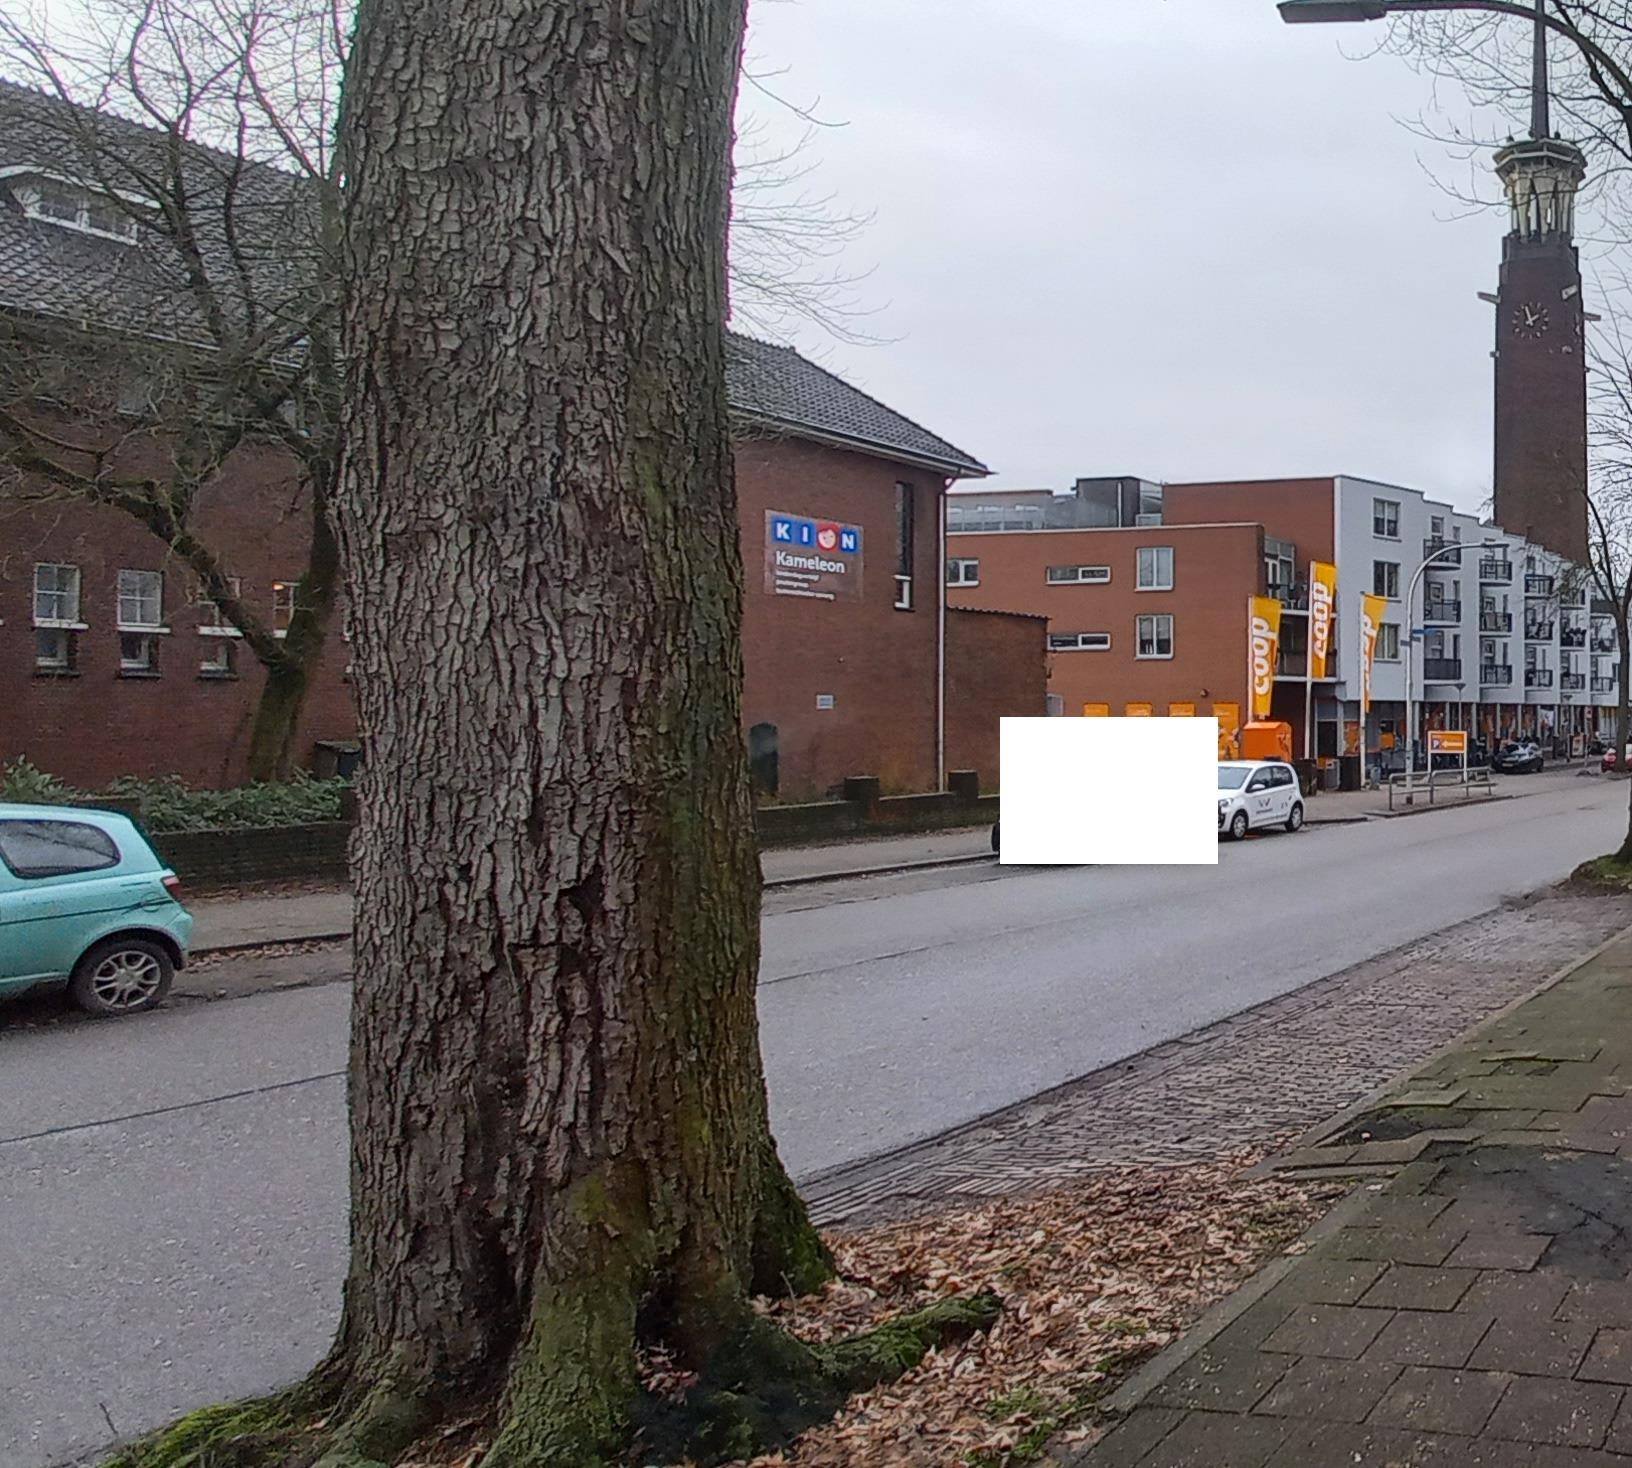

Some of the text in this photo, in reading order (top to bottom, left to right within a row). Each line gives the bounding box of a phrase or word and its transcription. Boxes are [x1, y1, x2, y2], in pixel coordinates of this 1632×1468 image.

[776, 550, 845, 573] Kameleon
[1252, 616, 1278, 695] coop
[1314, 582, 1333, 659] coop
